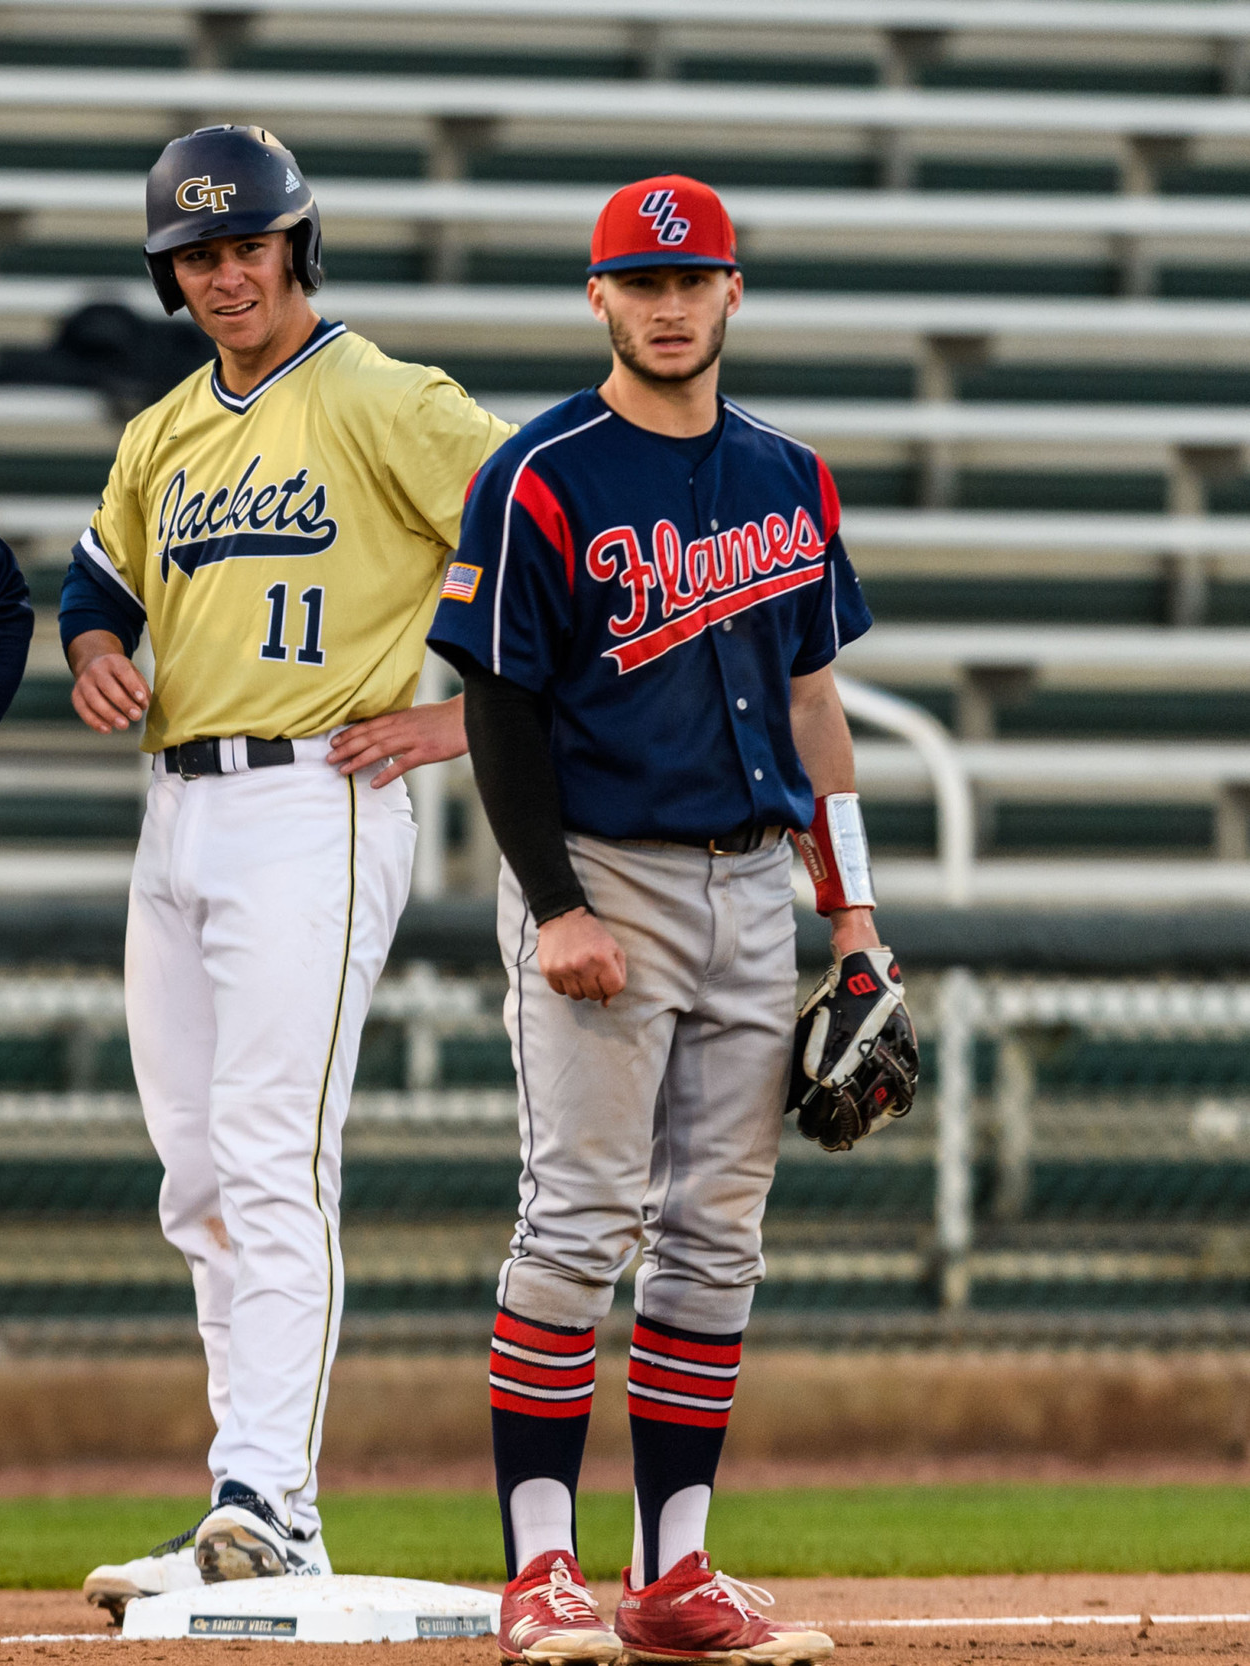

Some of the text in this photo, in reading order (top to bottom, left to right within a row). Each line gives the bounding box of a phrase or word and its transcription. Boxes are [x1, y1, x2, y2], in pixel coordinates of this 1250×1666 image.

[175, 175, 237, 214] GT
[638, 189, 691, 246] UIC
[157, 454, 330, 584] Jackets
[586, 505, 826, 637] Flames
[259, 581, 325, 667] 11
